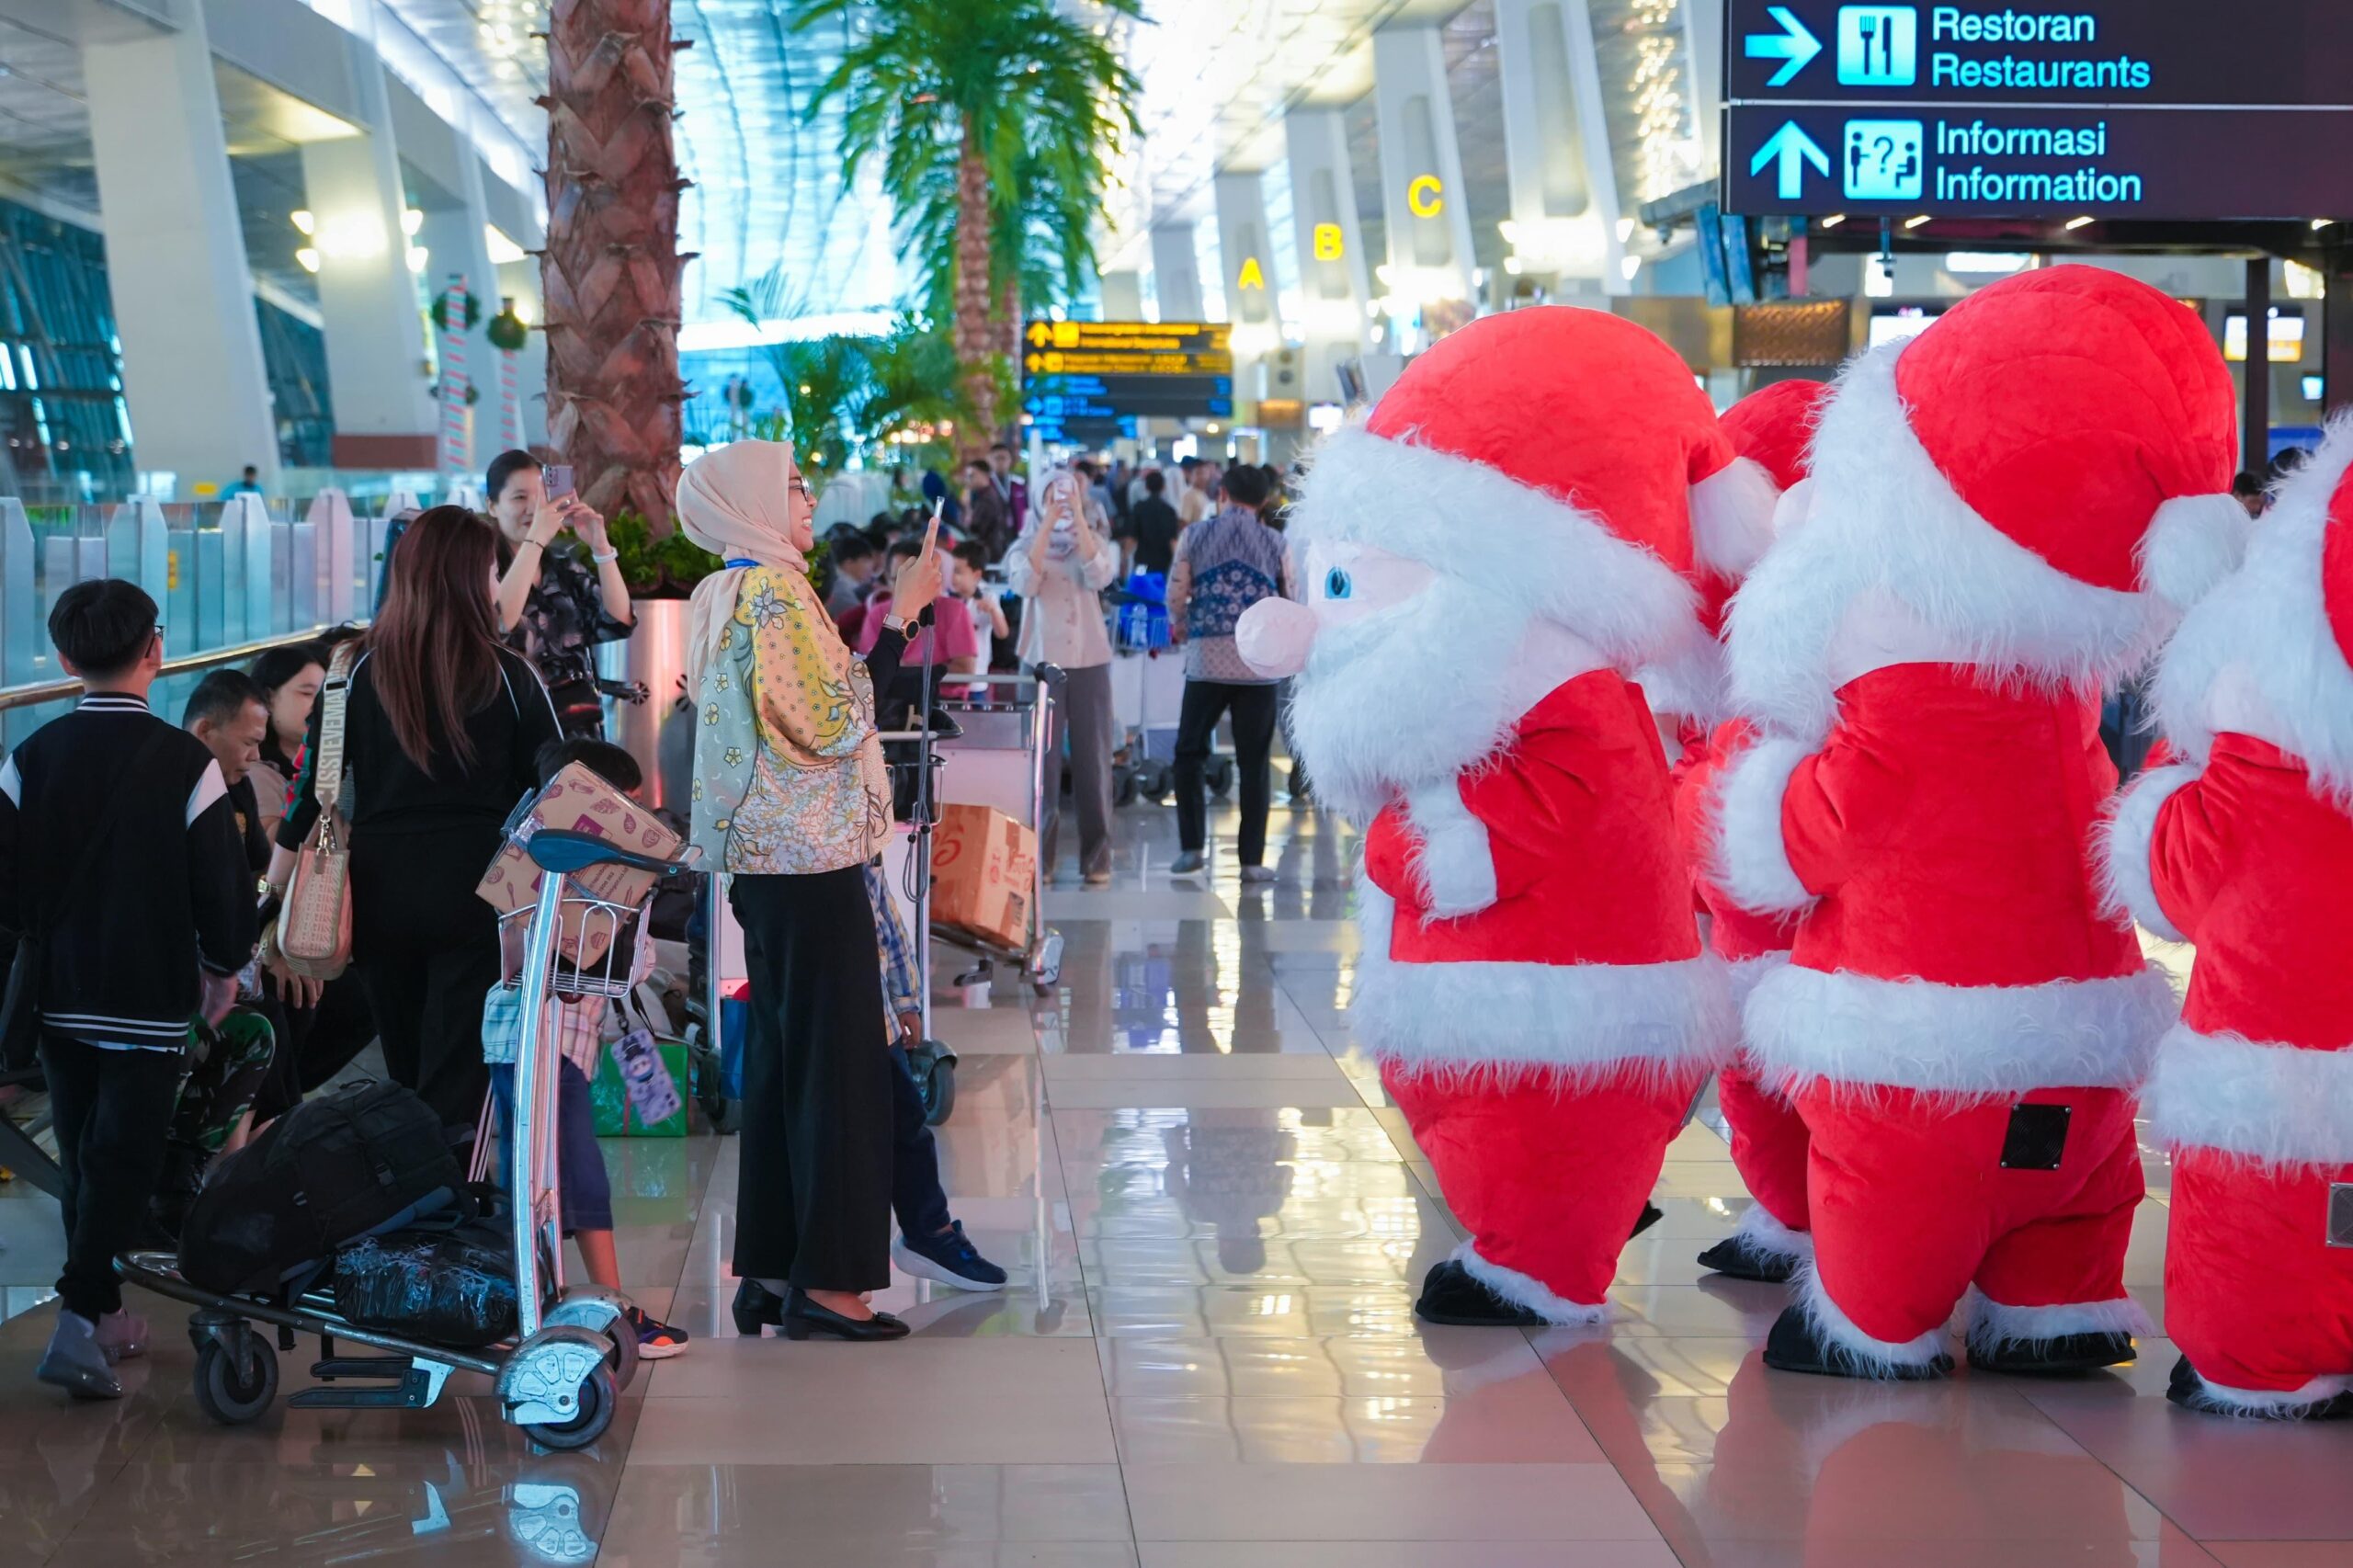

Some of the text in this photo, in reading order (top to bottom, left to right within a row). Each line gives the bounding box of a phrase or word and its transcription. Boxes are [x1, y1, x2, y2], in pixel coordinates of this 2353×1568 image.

[1932, 6, 2095, 42] Restoran
[1932, 52, 2151, 88] Restaurants
[1937, 119, 2106, 156] Informasi
[1408, 175, 1443, 218] C
[1937, 165, 2142, 202] Information
[1313, 223, 1344, 261] B
[1238, 257, 1264, 290] A
